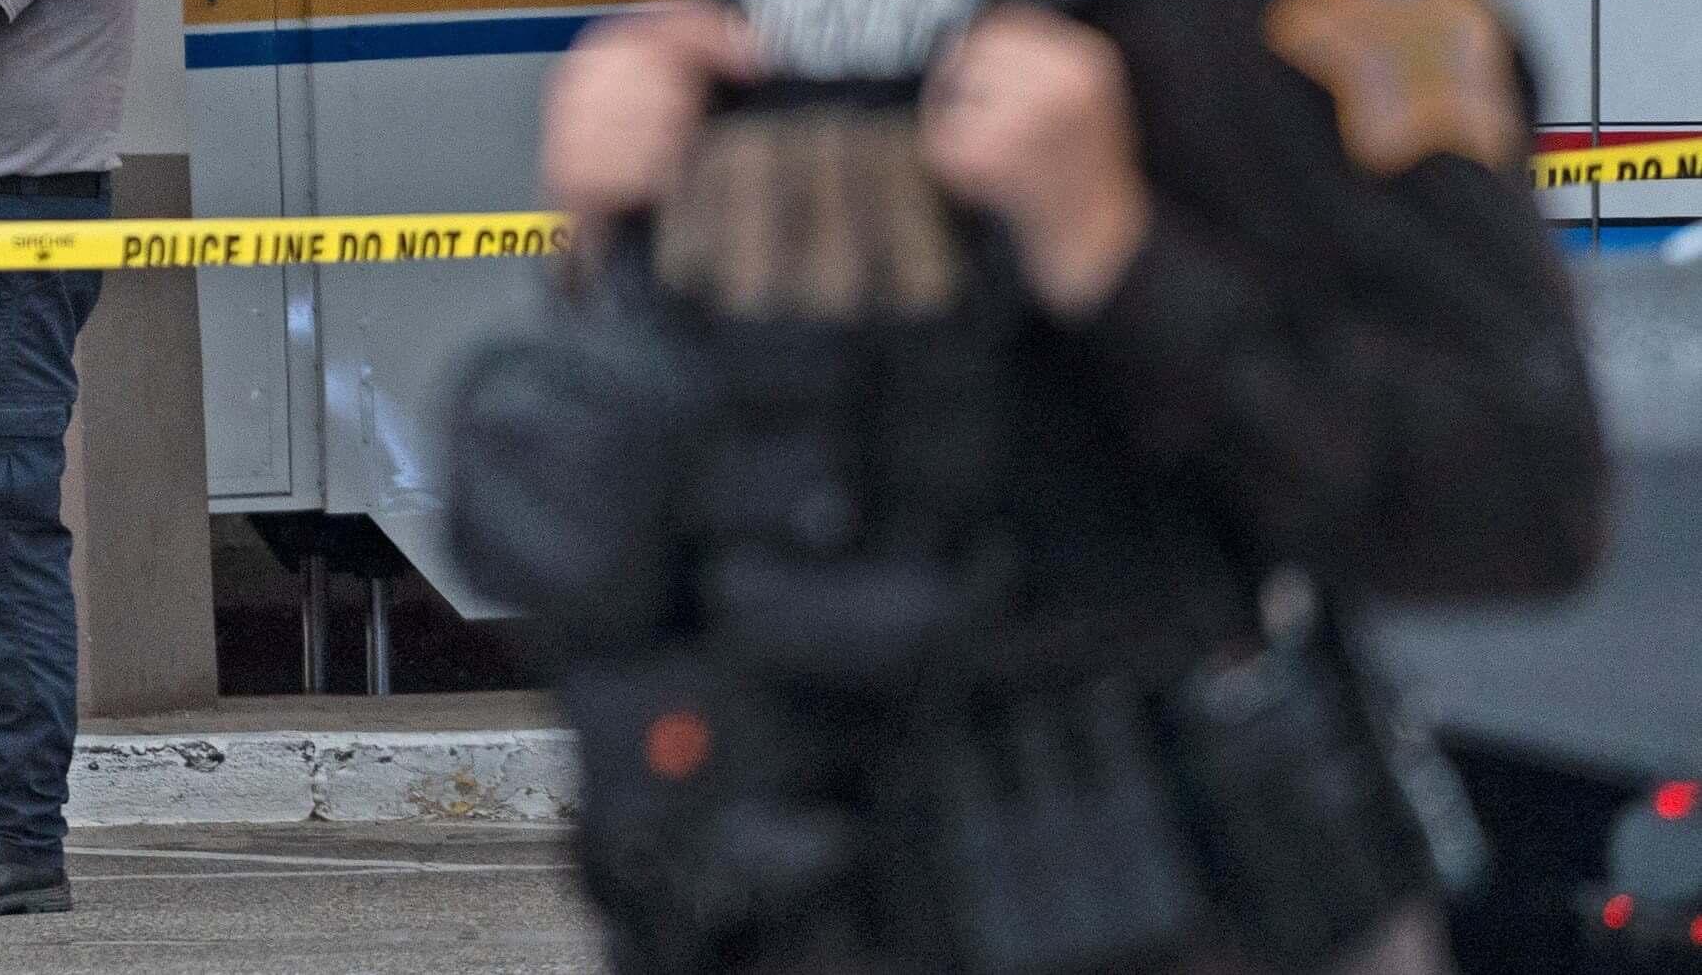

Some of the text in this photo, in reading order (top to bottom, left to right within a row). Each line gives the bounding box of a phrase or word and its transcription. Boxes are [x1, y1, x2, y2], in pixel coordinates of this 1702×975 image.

[1616, 159, 1663, 180] DO
[123, 233, 241, 267] POLICE
[253, 233, 325, 265] LINE
[339, 232, 382, 263] DO
[396, 230, 462, 260] NOT
